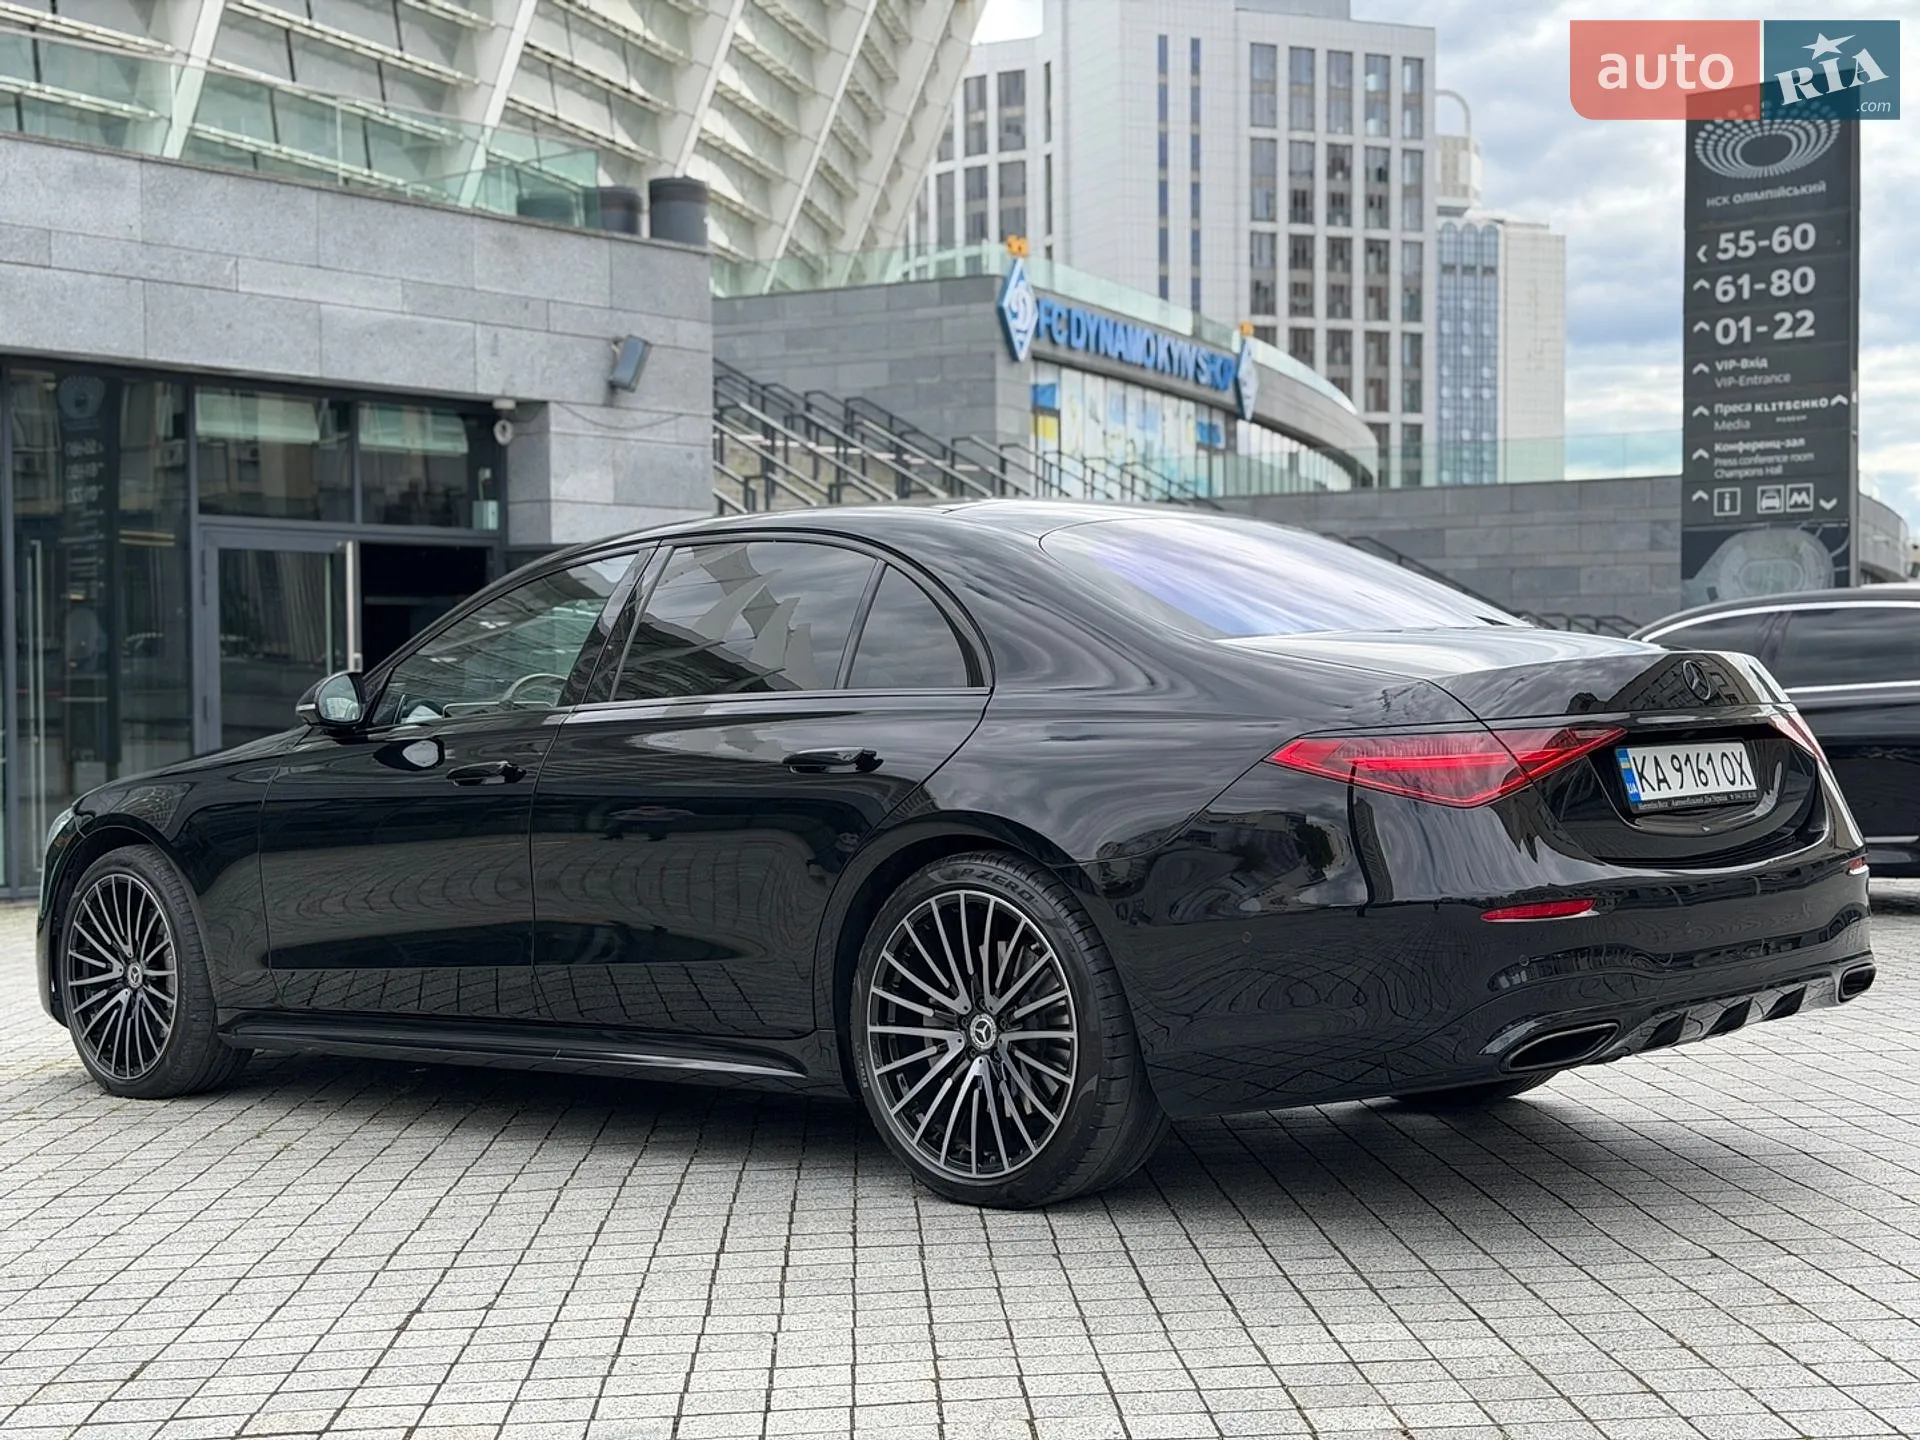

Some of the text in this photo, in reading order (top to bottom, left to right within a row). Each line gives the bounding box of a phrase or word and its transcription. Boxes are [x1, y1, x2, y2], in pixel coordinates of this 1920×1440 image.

[1716, 222, 1816, 260] 55-60
[1714, 266, 1816, 303] 61-80
[1037, 297, 1068, 344] FC
[1070, 308, 1156, 368] DYNAMO
[1714, 373, 1791, 388] VIP-Entrance
[1714, 402, 1752, 416] Преса
[1754, 397, 1829, 412] KLITSCHKO
[1714, 419, 1751, 431] Media
[1790, 452, 1815, 462] room
[1765, 464, 1784, 476] Hall
[976, 870, 1036, 904] ZERO
